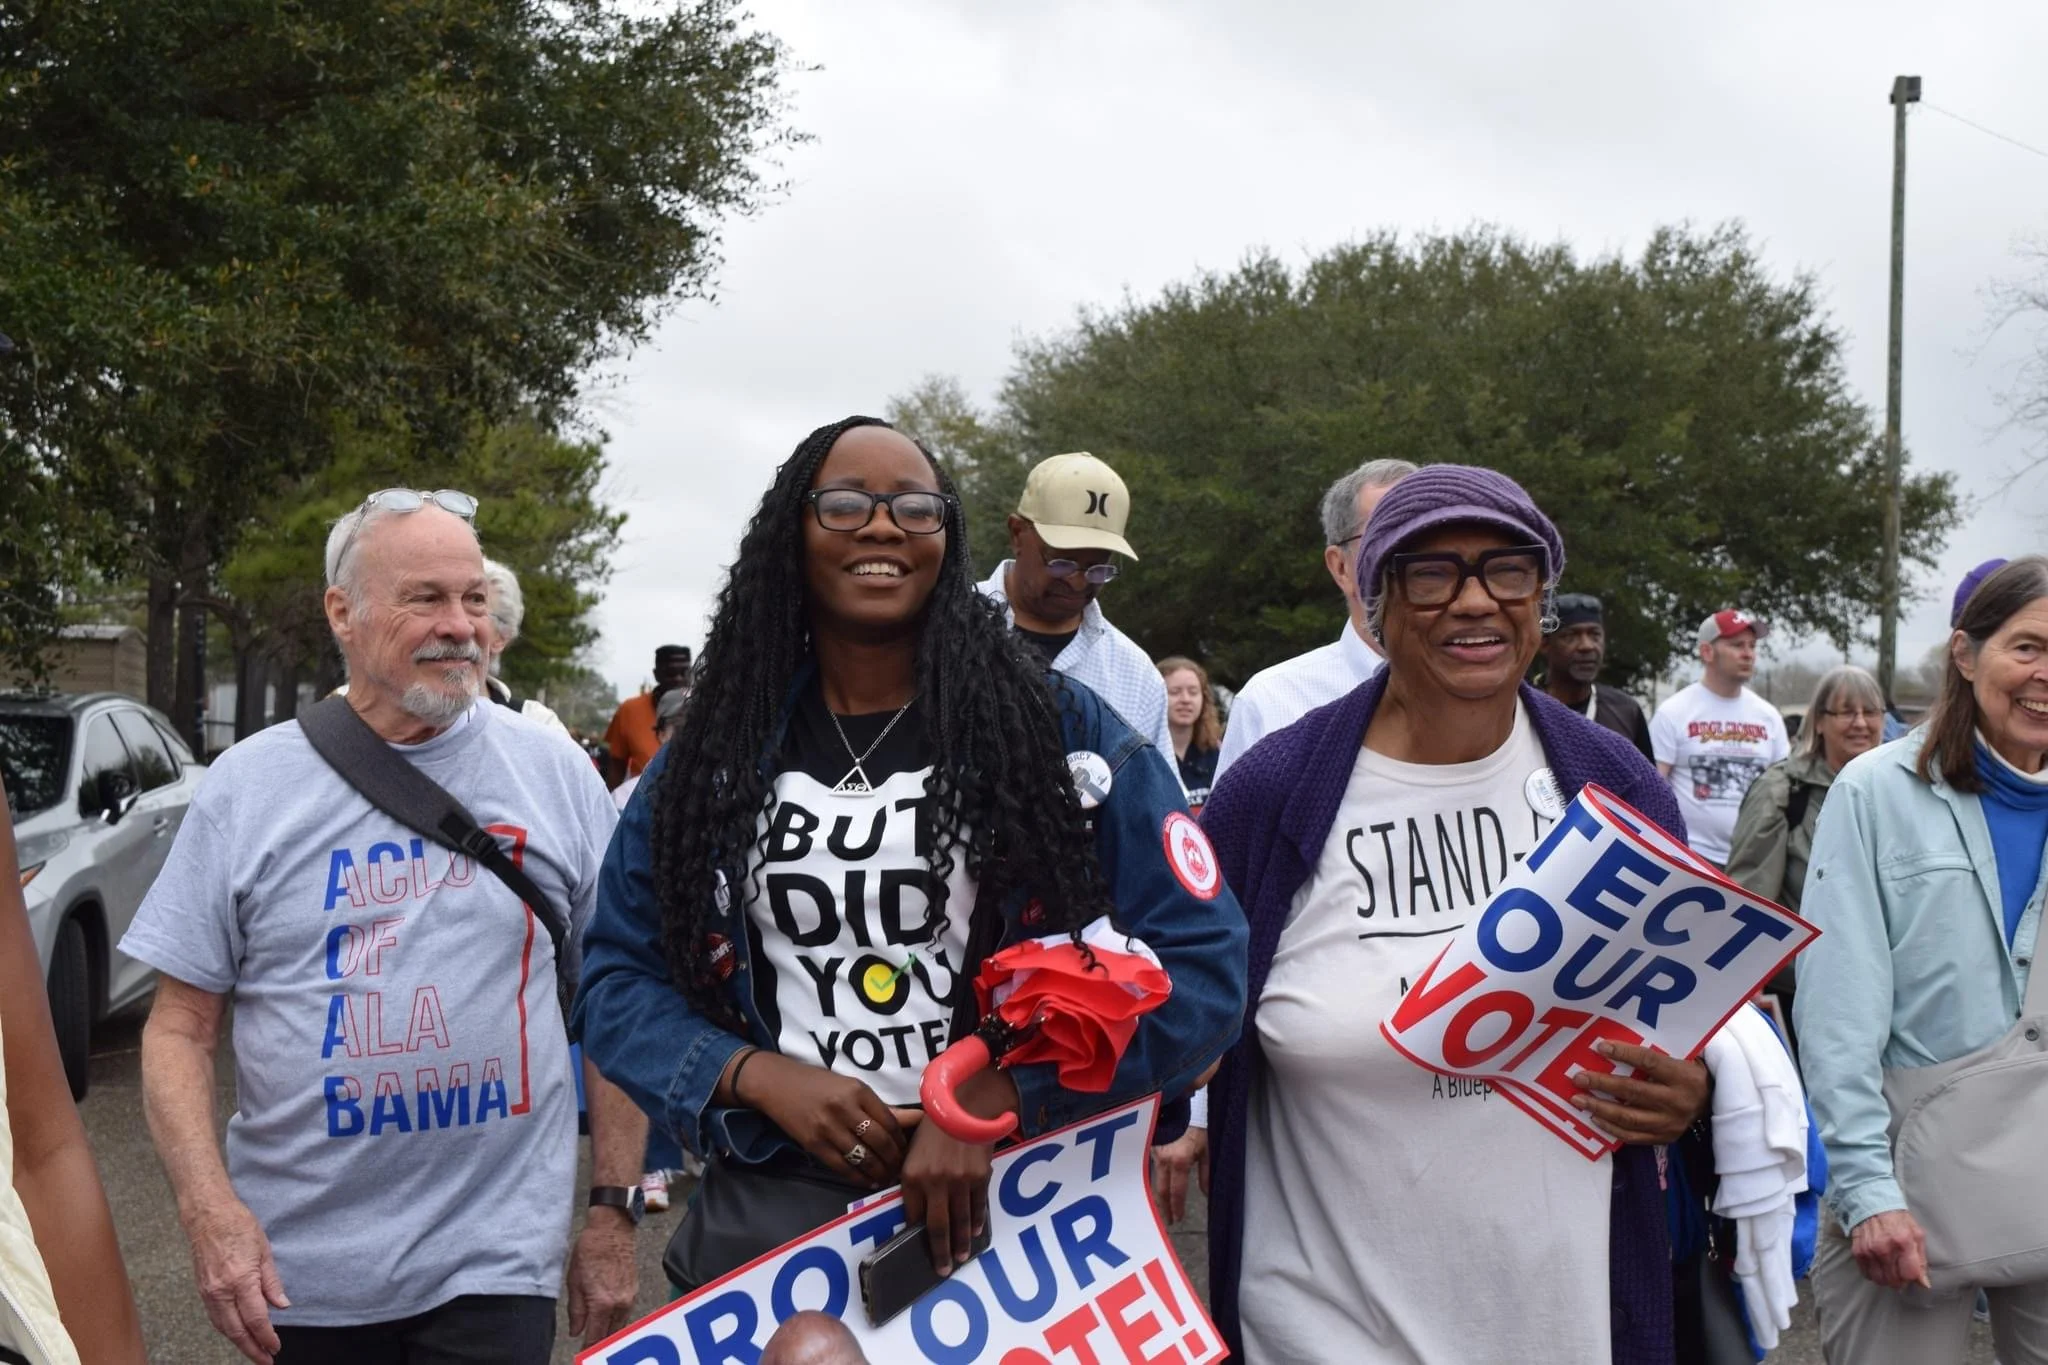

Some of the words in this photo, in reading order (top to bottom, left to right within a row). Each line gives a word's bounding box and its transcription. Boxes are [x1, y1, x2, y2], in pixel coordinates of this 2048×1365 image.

[765, 797, 935, 863] BUT
[1345, 806, 1543, 919] STAND-
[323, 838, 478, 911] ACLU
[766, 869, 937, 948] DID
[324, 917, 405, 980] OF
[796, 948, 958, 1018] YOU
[1477, 887, 1697, 1029] OUR
[321, 985, 450, 1059] ALA
[808, 1017, 950, 1071] VOTE
[1391, 938, 1673, 1114] VOTE
[323, 1057, 509, 1138] BAMA
[1432, 1073, 1444, 1099] A
[1448, 1075, 1497, 1102] Bluep
[910, 1195, 1130, 1363] OUR
